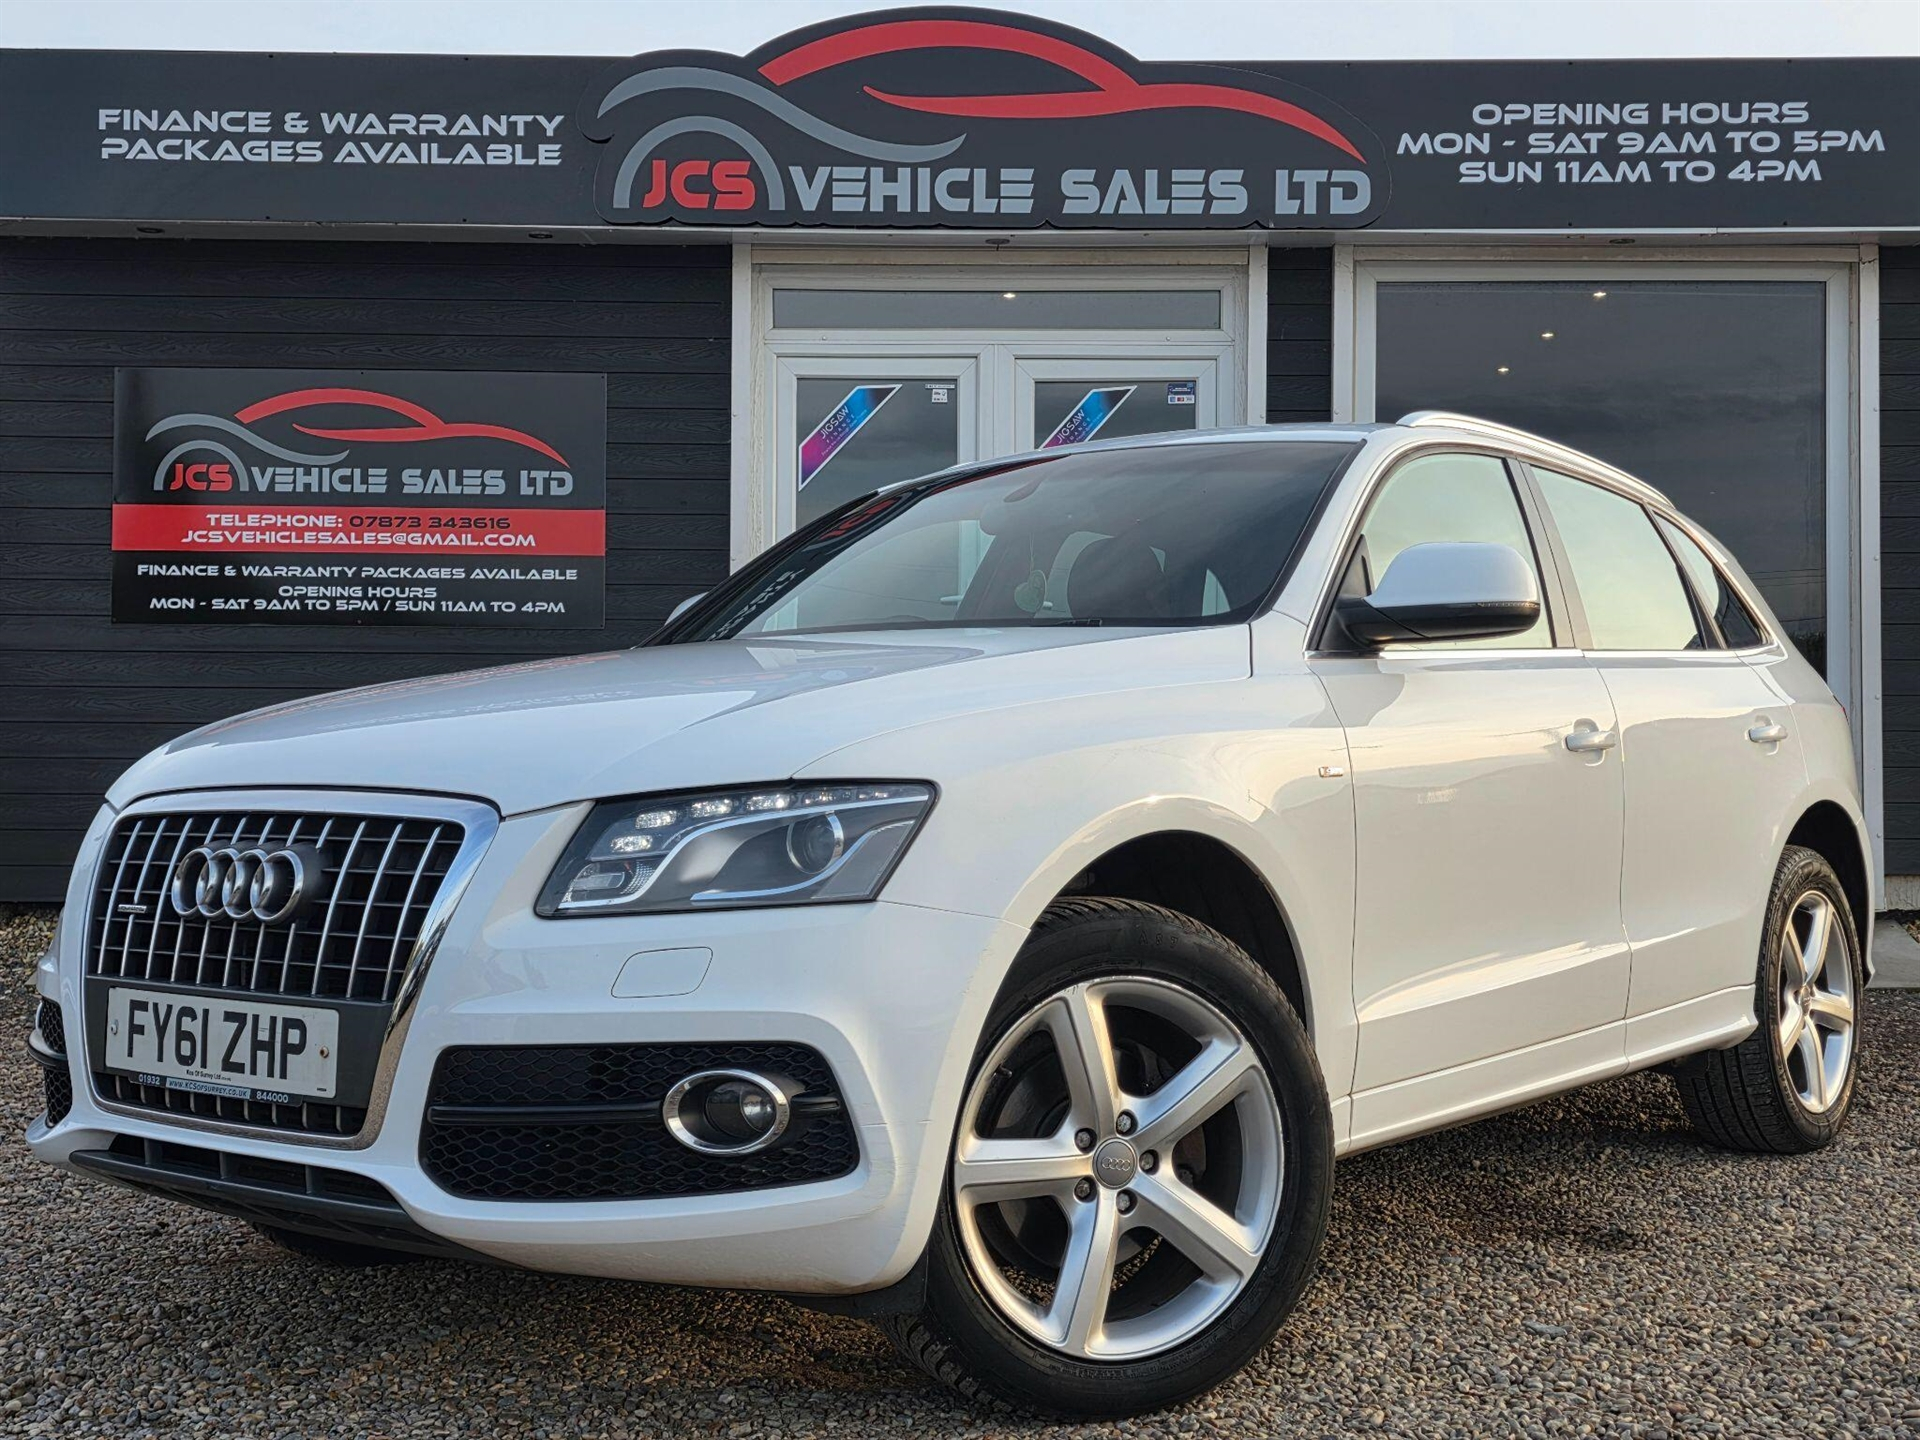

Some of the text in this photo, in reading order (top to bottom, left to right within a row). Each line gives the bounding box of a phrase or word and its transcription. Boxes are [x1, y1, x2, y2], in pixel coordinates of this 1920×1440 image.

[98, 108, 564, 137] FINANCE & WARRANTY
[1472, 101, 1810, 125] OPENING HOURS
[101, 138, 562, 166] PACKAGES AVAILABLE
[1397, 132, 1491, 155] MON
[1528, 132, 1606, 154] SAT
[1617, 131, 1717, 154] 9AM
[1725, 129, 1782, 153] TO
[1793, 129, 1886, 152] 5PM
[1459, 159, 1823, 183] SUN 11AM TO 4PM
[642, 159, 1371, 215] JCS VEHICLE SALES LTD
[820, 405, 849, 439] JIGSAW
[1056, 409, 1085, 444] JIGSAW
[1067, 417, 1091, 443] INANCE
[170, 463, 574, 496] JCS VEHICLE SALES LTD
[206, 513, 511, 529] TELEPHONE: 07873 343616
[181, 530, 536, 547] JCSVEHICLESALES@GMAIL.COM
[137, 564, 578, 581] FINANCE & WARRANTY PACKAGES AVAILABLE
[278, 585, 437, 598] OPENING HOURS
[149, 598, 196, 610] MON
[211, 598, 251, 610] SAT
[255, 599, 301, 611] 9AM
[305, 599, 330, 611] TO
[335, 600, 379, 612] 5PM
[395, 600, 435, 612] SUN
[440, 601, 486, 613] 11AM
[490, 601, 516, 613] TO
[521, 602, 566, 614] 4PM
[127, 999, 307, 1080] FY61 ZHP
[138, 1074, 160, 1085] 01932
[256, 1091, 289, 1103] 844000
